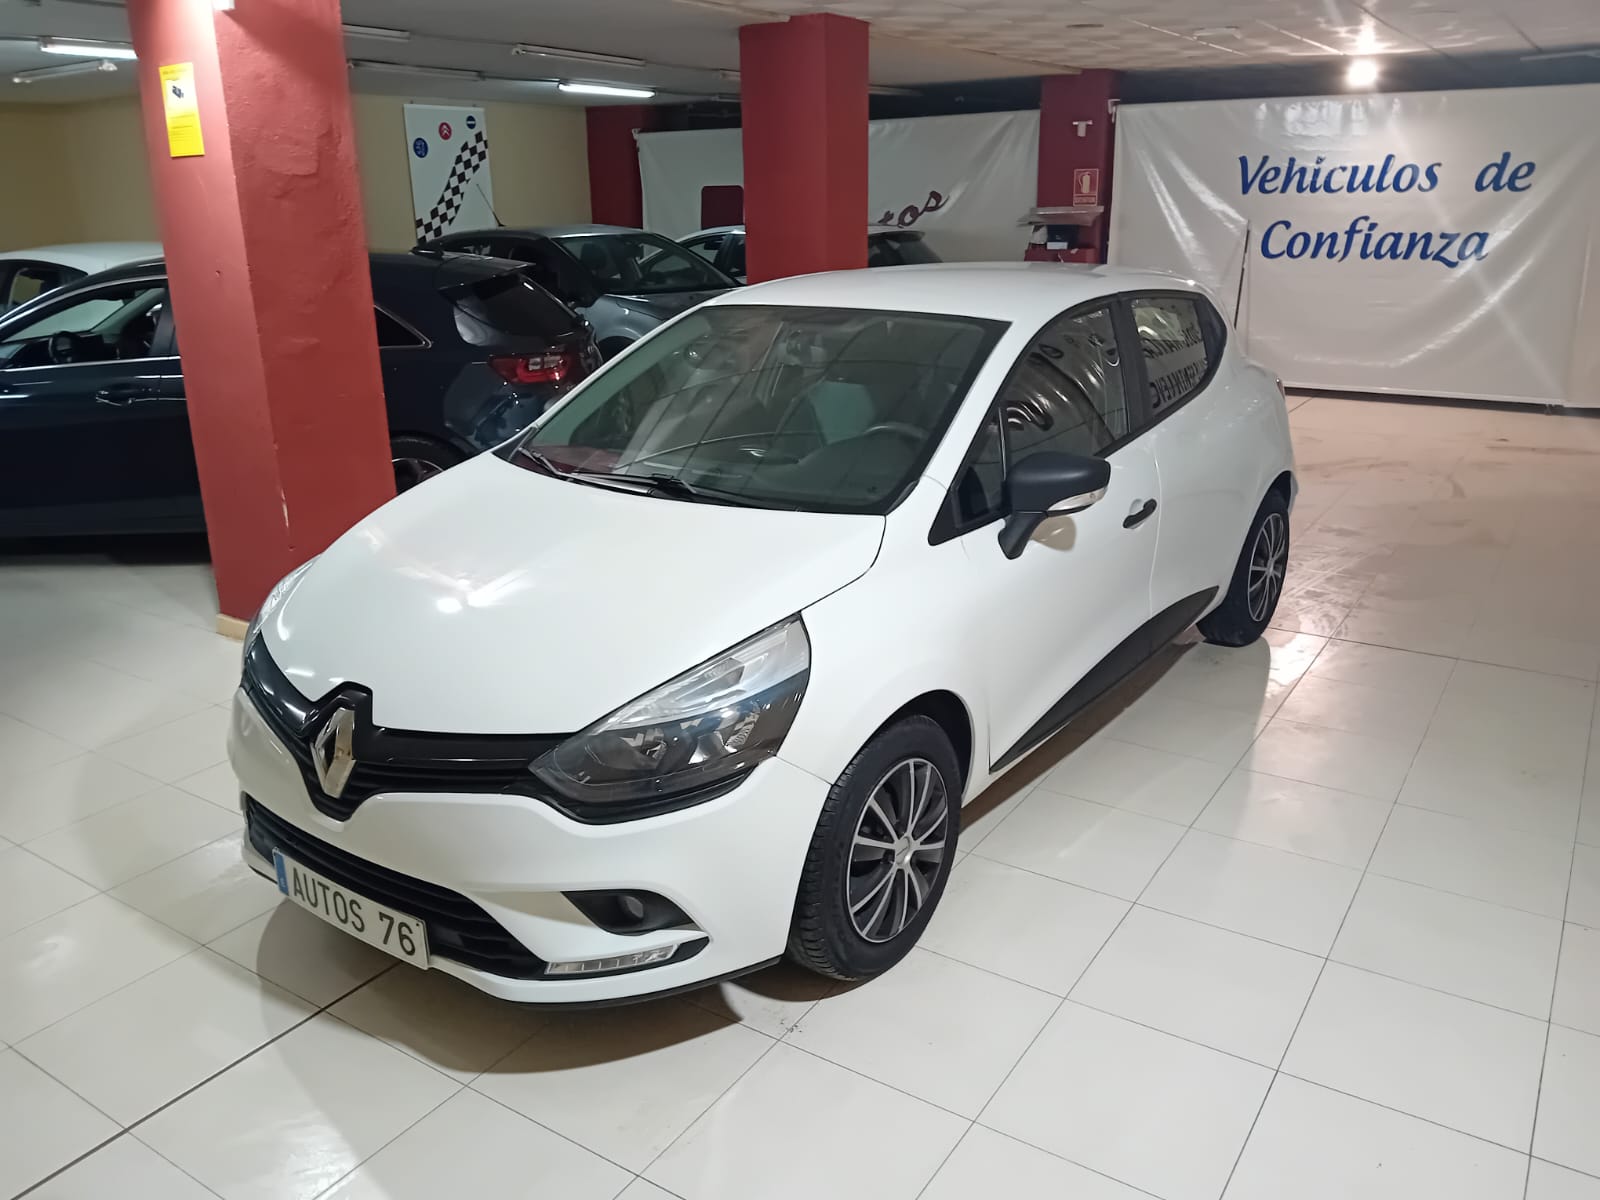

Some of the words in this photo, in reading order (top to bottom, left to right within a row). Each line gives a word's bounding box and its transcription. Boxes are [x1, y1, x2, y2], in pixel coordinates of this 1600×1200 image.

[1475, 151, 1536, 192] de
[1260, 216, 1490, 268] Confianza
[293, 866, 365, 933] AUTOS
[378, 911, 416, 956] 76
